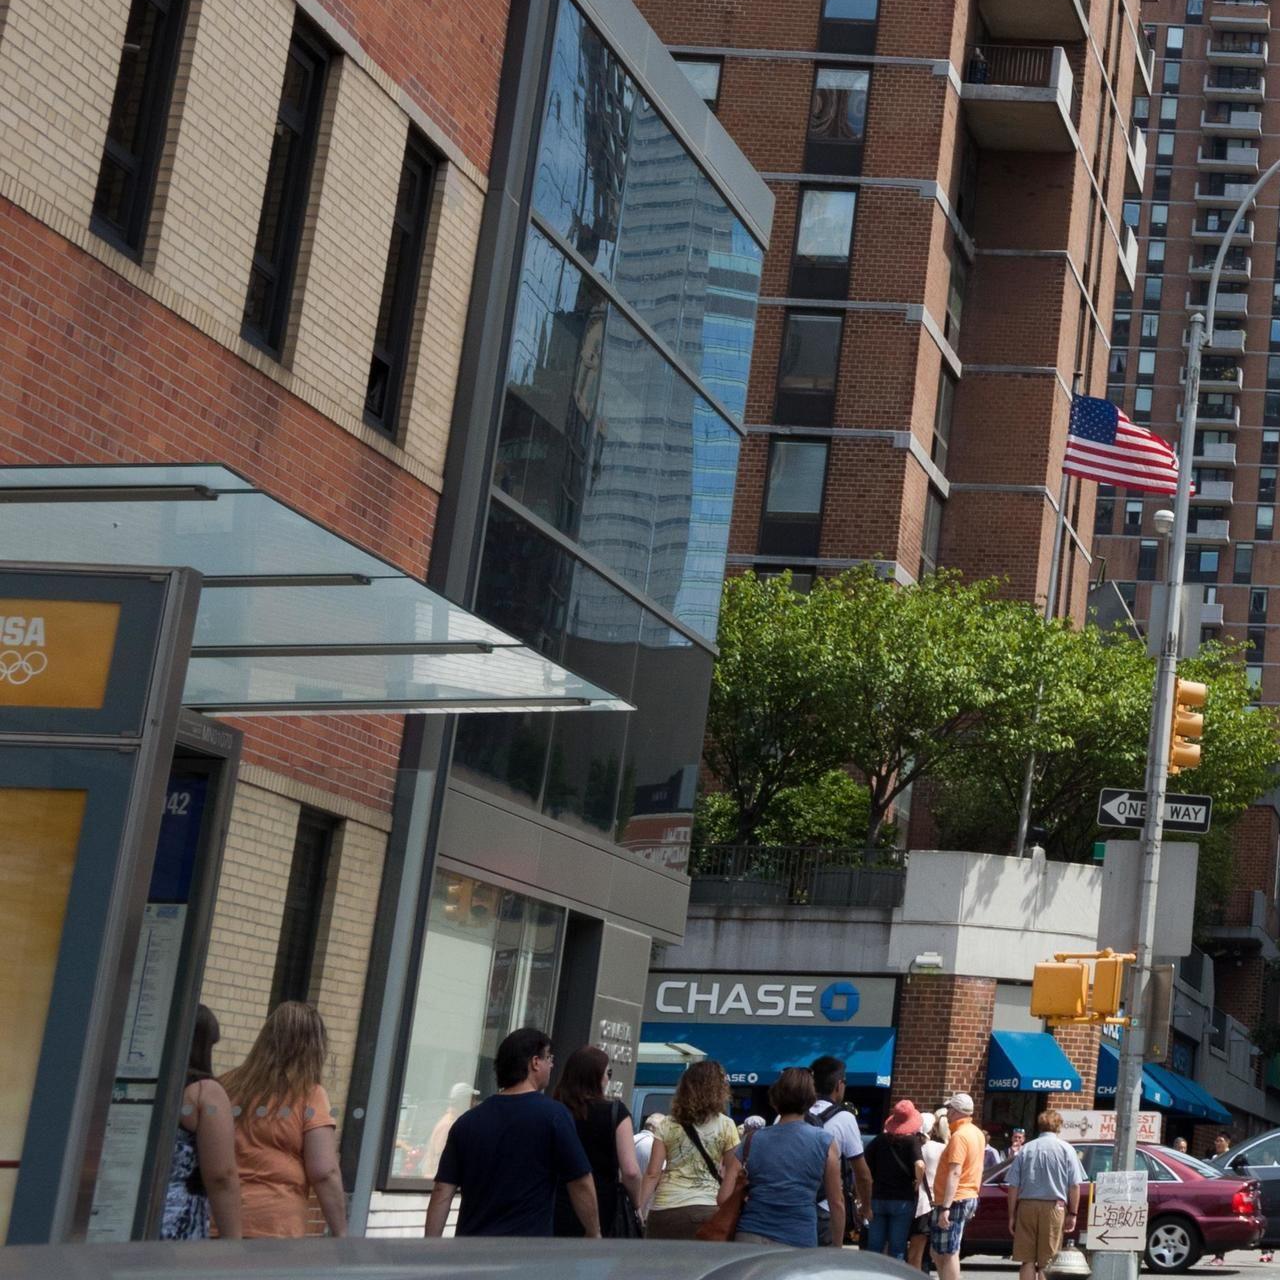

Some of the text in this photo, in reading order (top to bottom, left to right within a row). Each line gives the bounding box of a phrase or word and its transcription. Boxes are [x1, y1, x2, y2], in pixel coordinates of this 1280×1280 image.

[1117, 800, 1202, 821] ONE WAY
[656, 980, 817, 1017] CHASE
[725, 1073, 746, 1083] ASE
[988, 1078, 1012, 1088] CHASE
[1032, 1079, 1062, 1089] CHASE
[1097, 1086, 1118, 1095] CHA
[1063, 1122, 1093, 1130] ORMON
